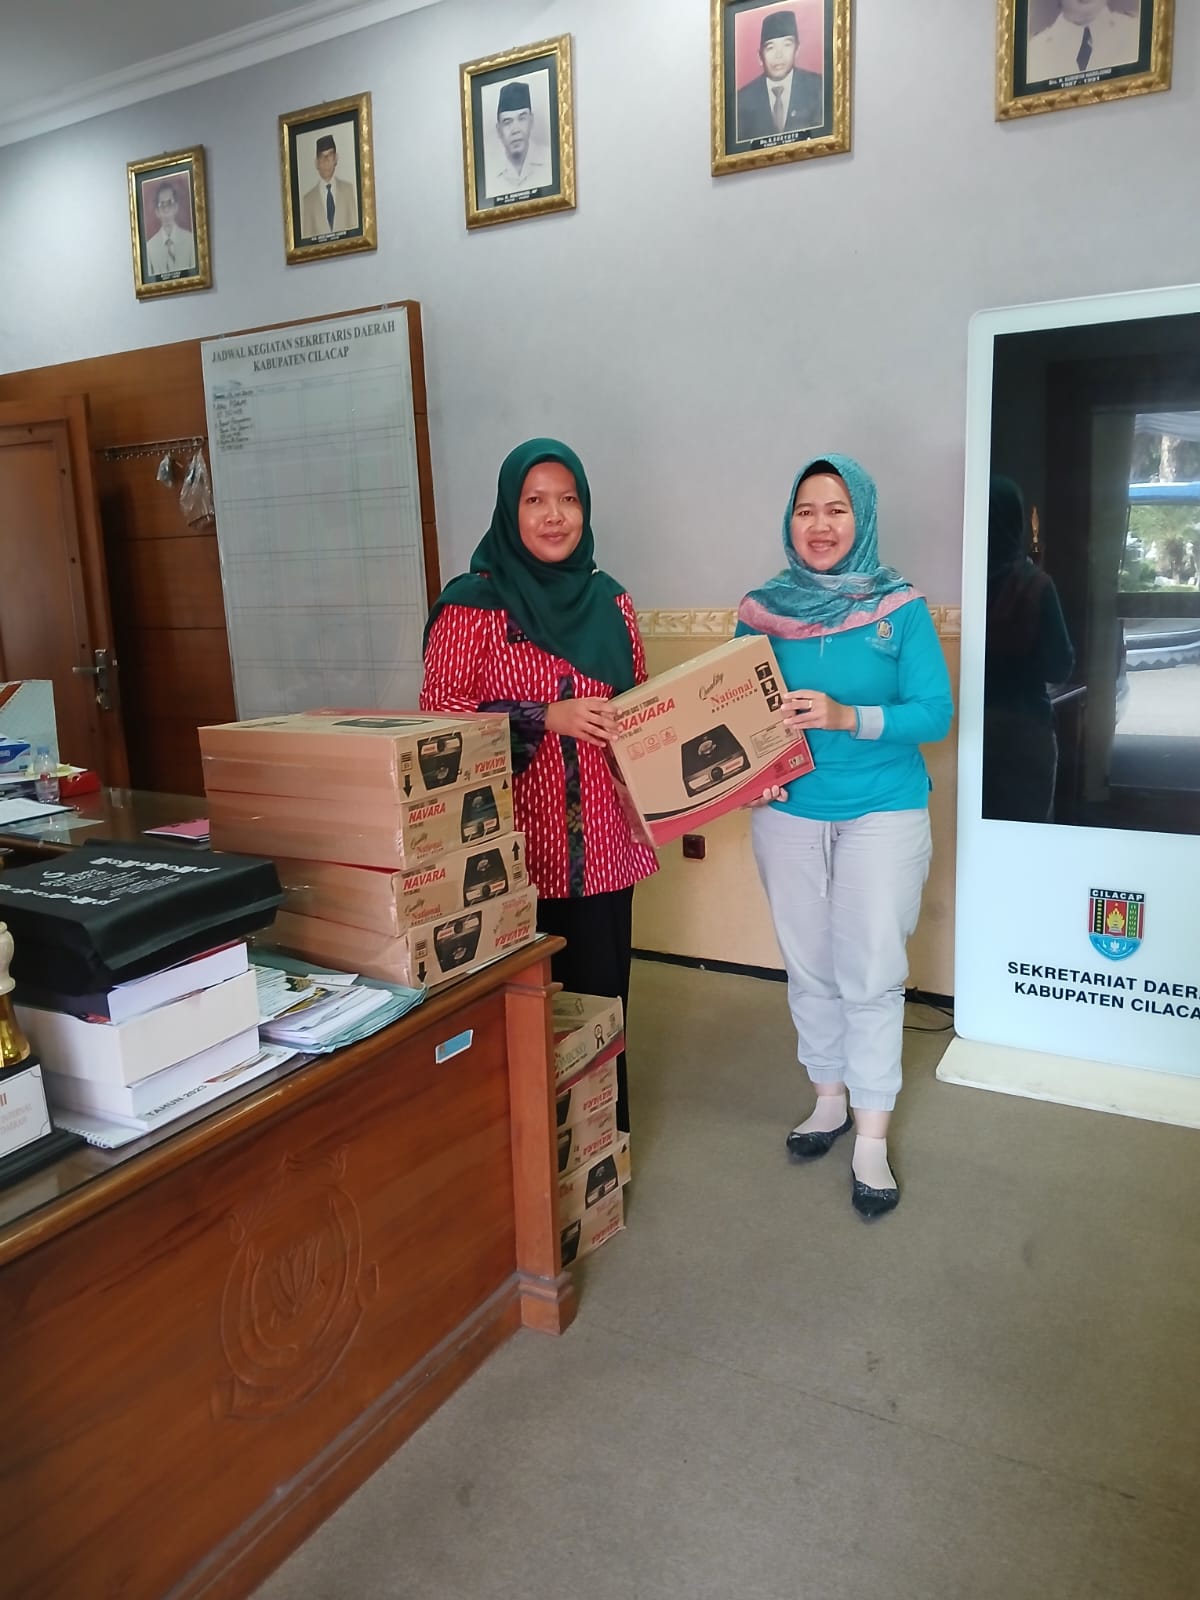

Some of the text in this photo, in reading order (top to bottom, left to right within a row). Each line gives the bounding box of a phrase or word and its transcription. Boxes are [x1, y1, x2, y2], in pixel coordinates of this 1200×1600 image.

[211, 320, 396, 363] JADWAL KEGIATAN SEKRETARIS DAERAH
[252, 346, 350, 373] KABUPATEN CILACAP
[698, 672, 724, 702] Quality
[710, 679, 754, 704] National
[618, 697, 676, 733] NAVARA
[408, 802, 446, 823] NAVARA
[403, 867, 446, 890] NAVARA
[1091, 889, 1143, 901] CILACAP
[1007, 961, 1200, 1000] SEKRETARIAT DAER
[1014, 981, 1200, 1020] KABUPATEN CILACA
[145, 1096, 184, 1117] TAHUN
